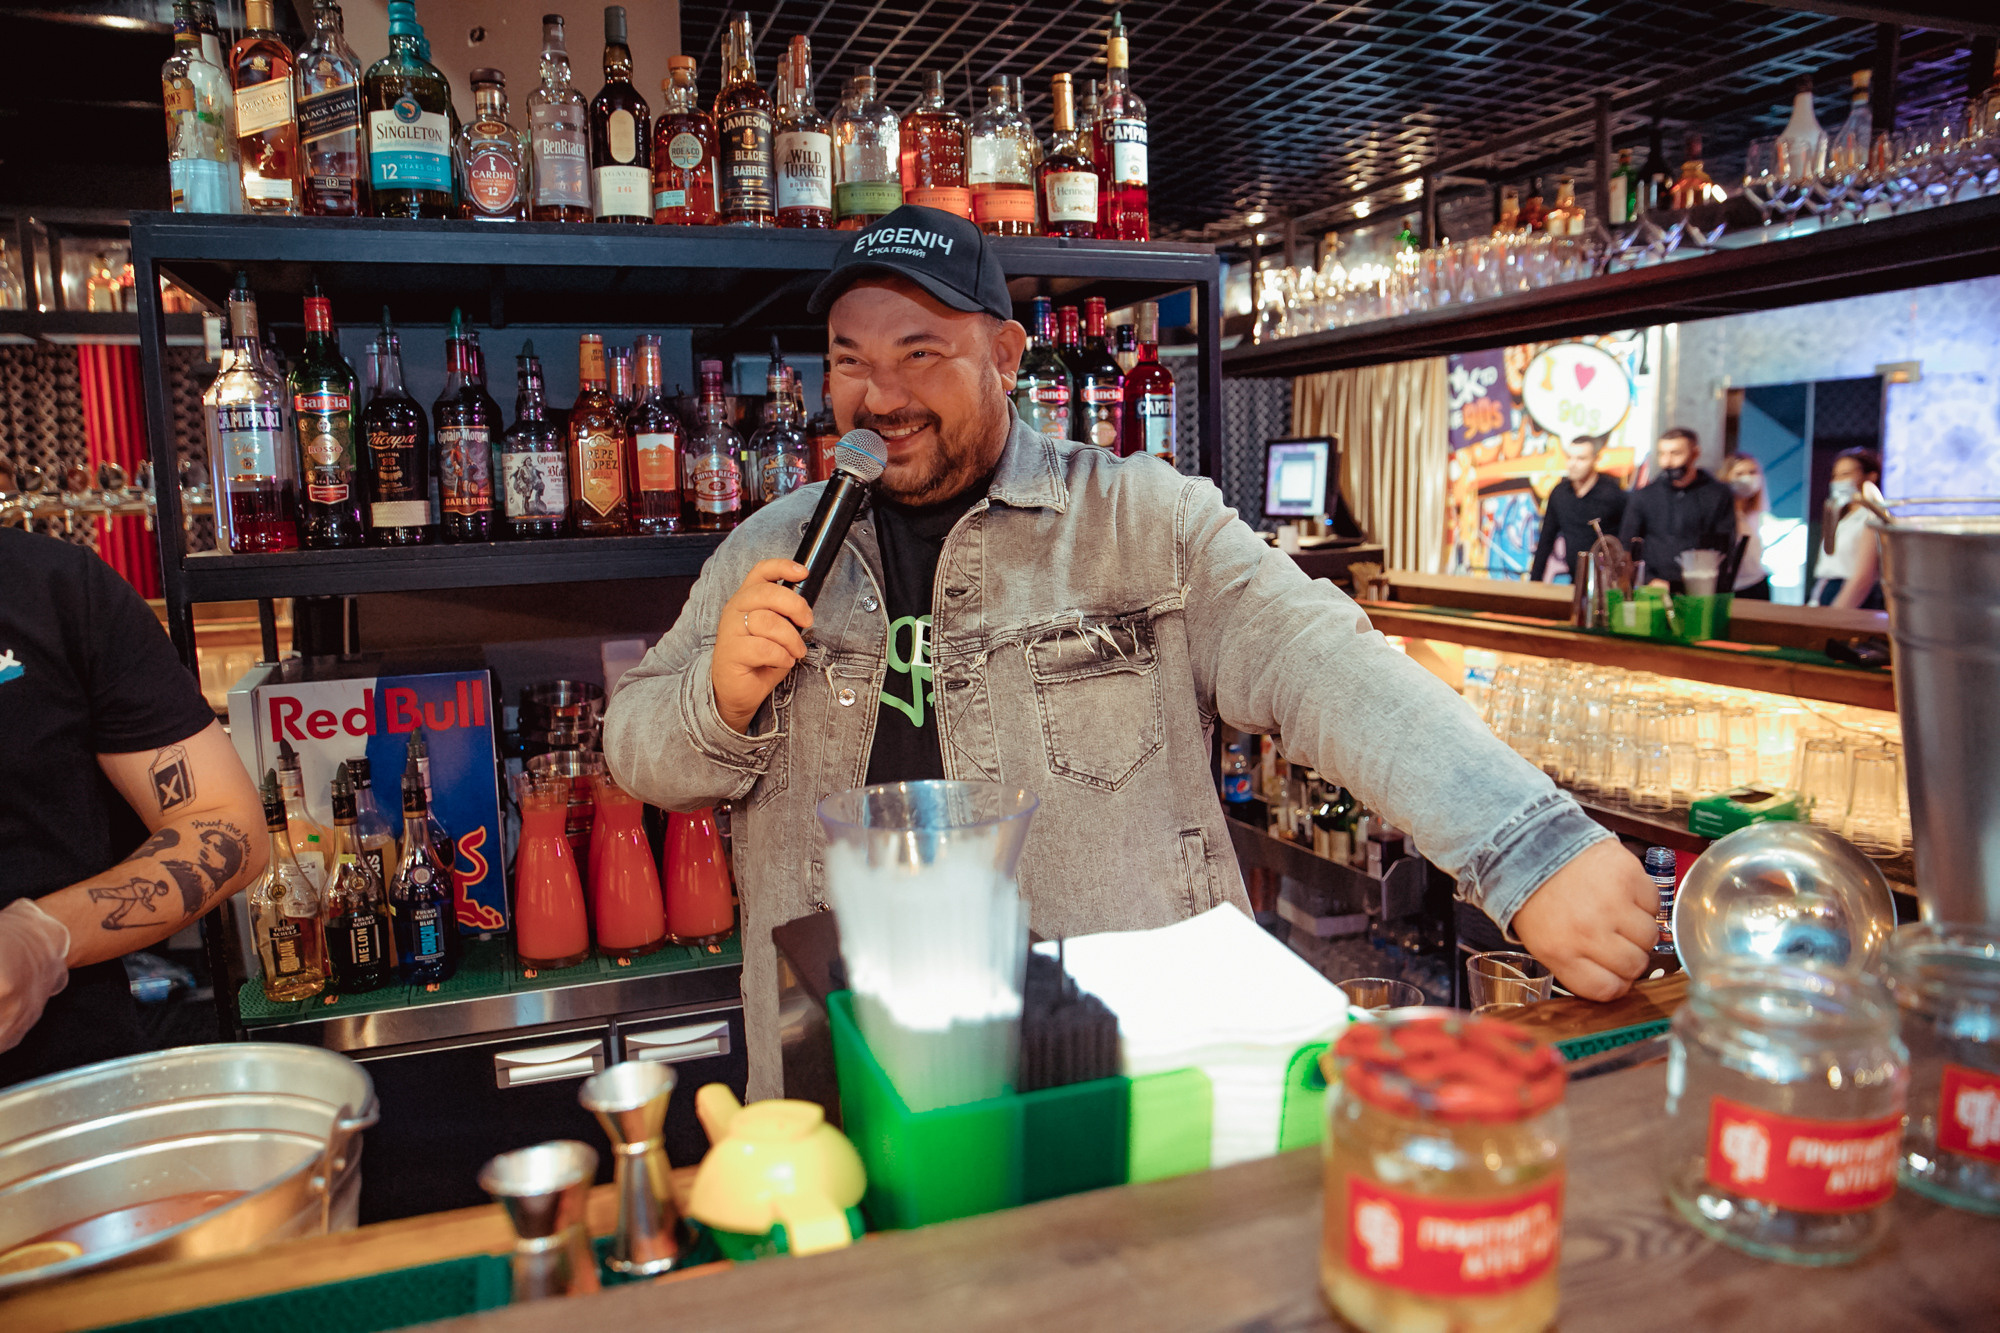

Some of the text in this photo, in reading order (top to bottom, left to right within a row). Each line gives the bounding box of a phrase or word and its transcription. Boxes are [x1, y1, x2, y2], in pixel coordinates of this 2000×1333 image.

[299, 107, 329, 122] BLACK
[330, 99, 357, 113] LABEL
[722, 115, 772, 134] JAMESON
[376, 123, 443, 142] SINGLETON
[735, 150, 766, 162] BLACK
[790, 149, 822, 164] WILD
[381, 163, 398, 180] 12
[426, 164, 441, 172] OLD
[733, 165, 768, 177] BARREL
[784, 161, 827, 179] TURKEY
[472, 170, 514, 180] CARDHU
[328, 179, 337, 187] 12
[487, 187, 499, 196] 12
[297, 397, 348, 408] Gancia
[368, 432, 418, 449] Zacapa
[437, 429, 489, 444] Captain Morgan
[537, 455, 557, 465] Captain
[588, 449, 614, 460] PEPE
[585, 460, 618, 470] LOPEZ
[693, 470, 740, 482] CHIVAS REGAL
[765, 466, 808, 477] CHIVAS REGAL
[779, 474, 798, 489] XV
[445, 497, 489, 506] DARK RUM
[268, 679, 486, 743] Red Bull
[415, 912, 437, 920] SCHULZ
[352, 919, 376, 928] SCHULZ
[357, 927, 370, 963] MELON
